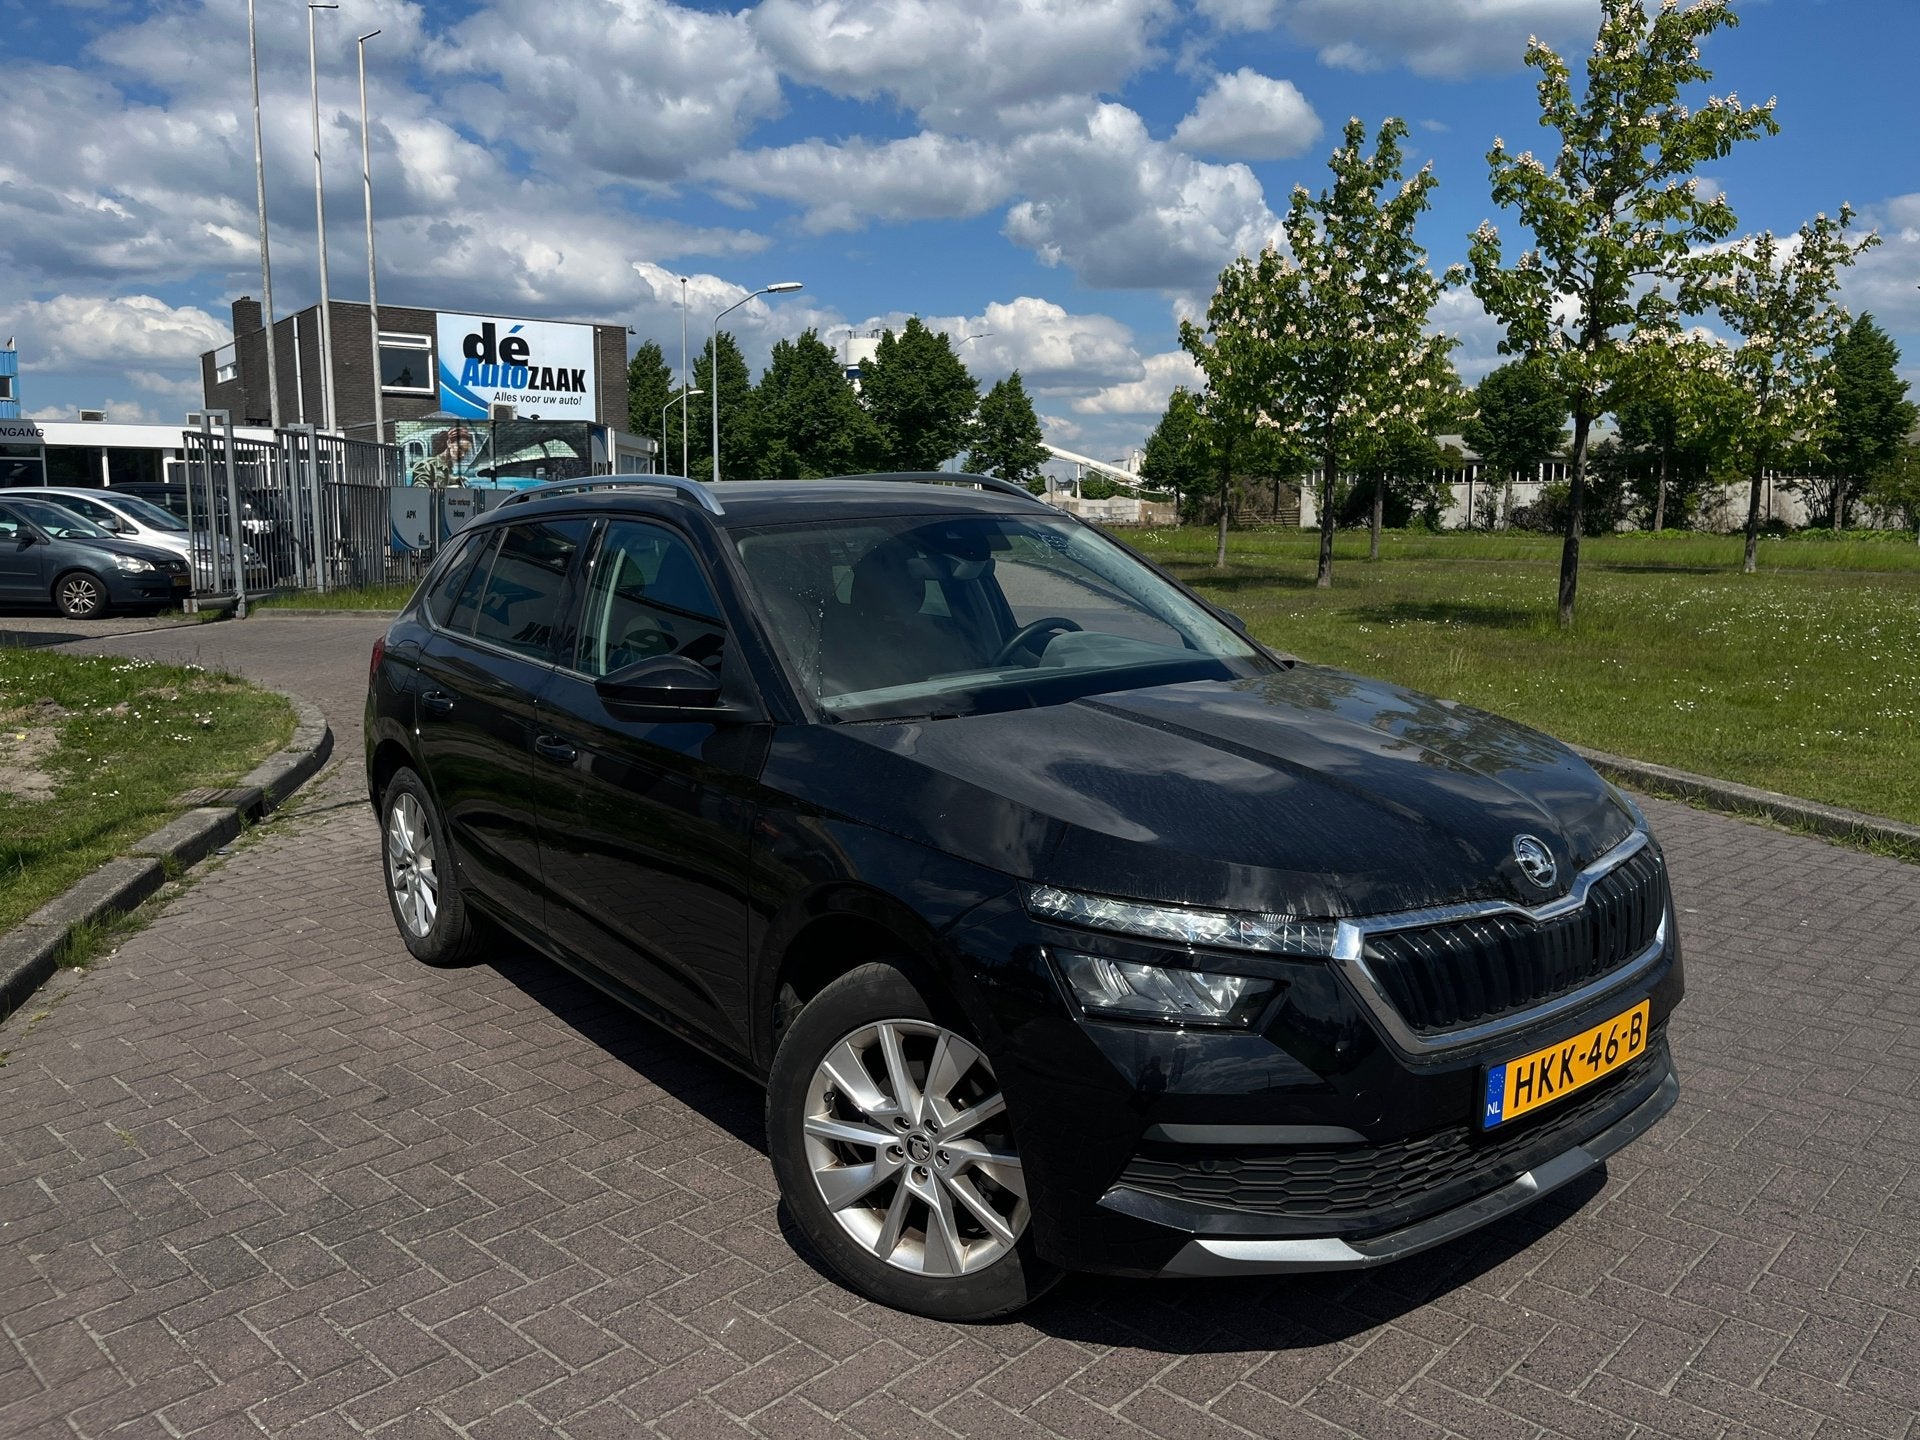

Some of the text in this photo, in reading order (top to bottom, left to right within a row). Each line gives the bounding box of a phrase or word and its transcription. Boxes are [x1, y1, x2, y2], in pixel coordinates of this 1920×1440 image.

[463, 322, 530, 367] dé
[460, 358, 586, 393] AutoZAAK
[493, 391, 582, 406] Alles voor uw auto!
[407, 510, 416, 519] APK
[1513, 1011, 1643, 1109] HKK-46-B
[1487, 1101, 1501, 1117] NL
